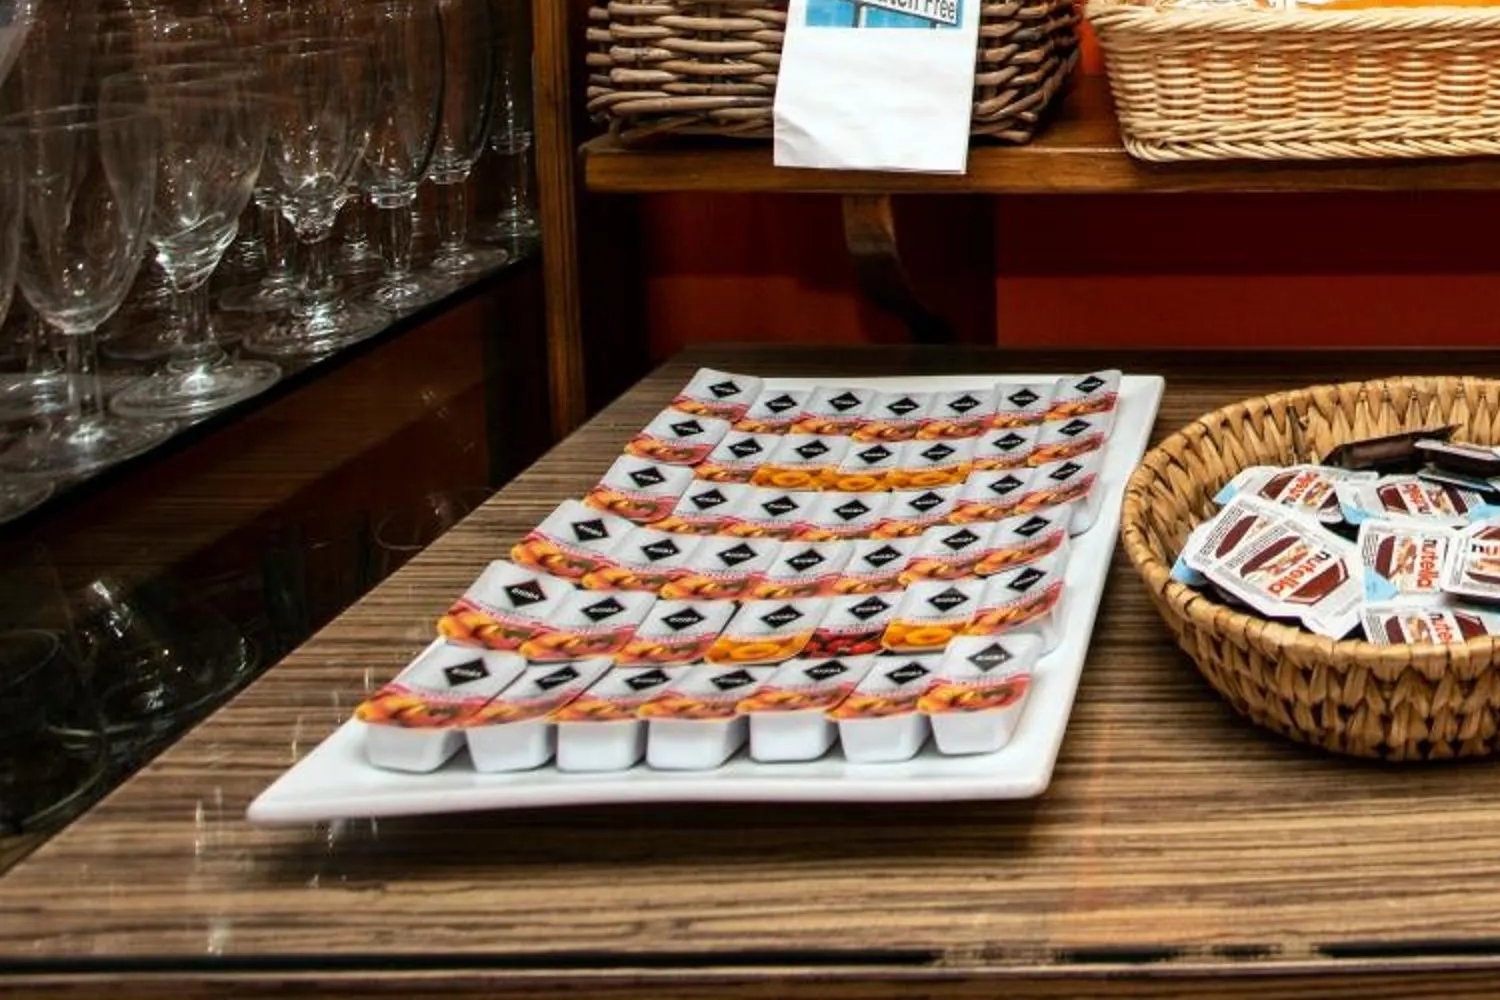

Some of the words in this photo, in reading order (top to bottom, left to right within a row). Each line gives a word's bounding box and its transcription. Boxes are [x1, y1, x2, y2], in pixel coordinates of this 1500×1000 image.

[1267, 550, 1332, 595] nutella
[1416, 538, 1439, 588] nutella
[1430, 613, 1454, 645] nute
